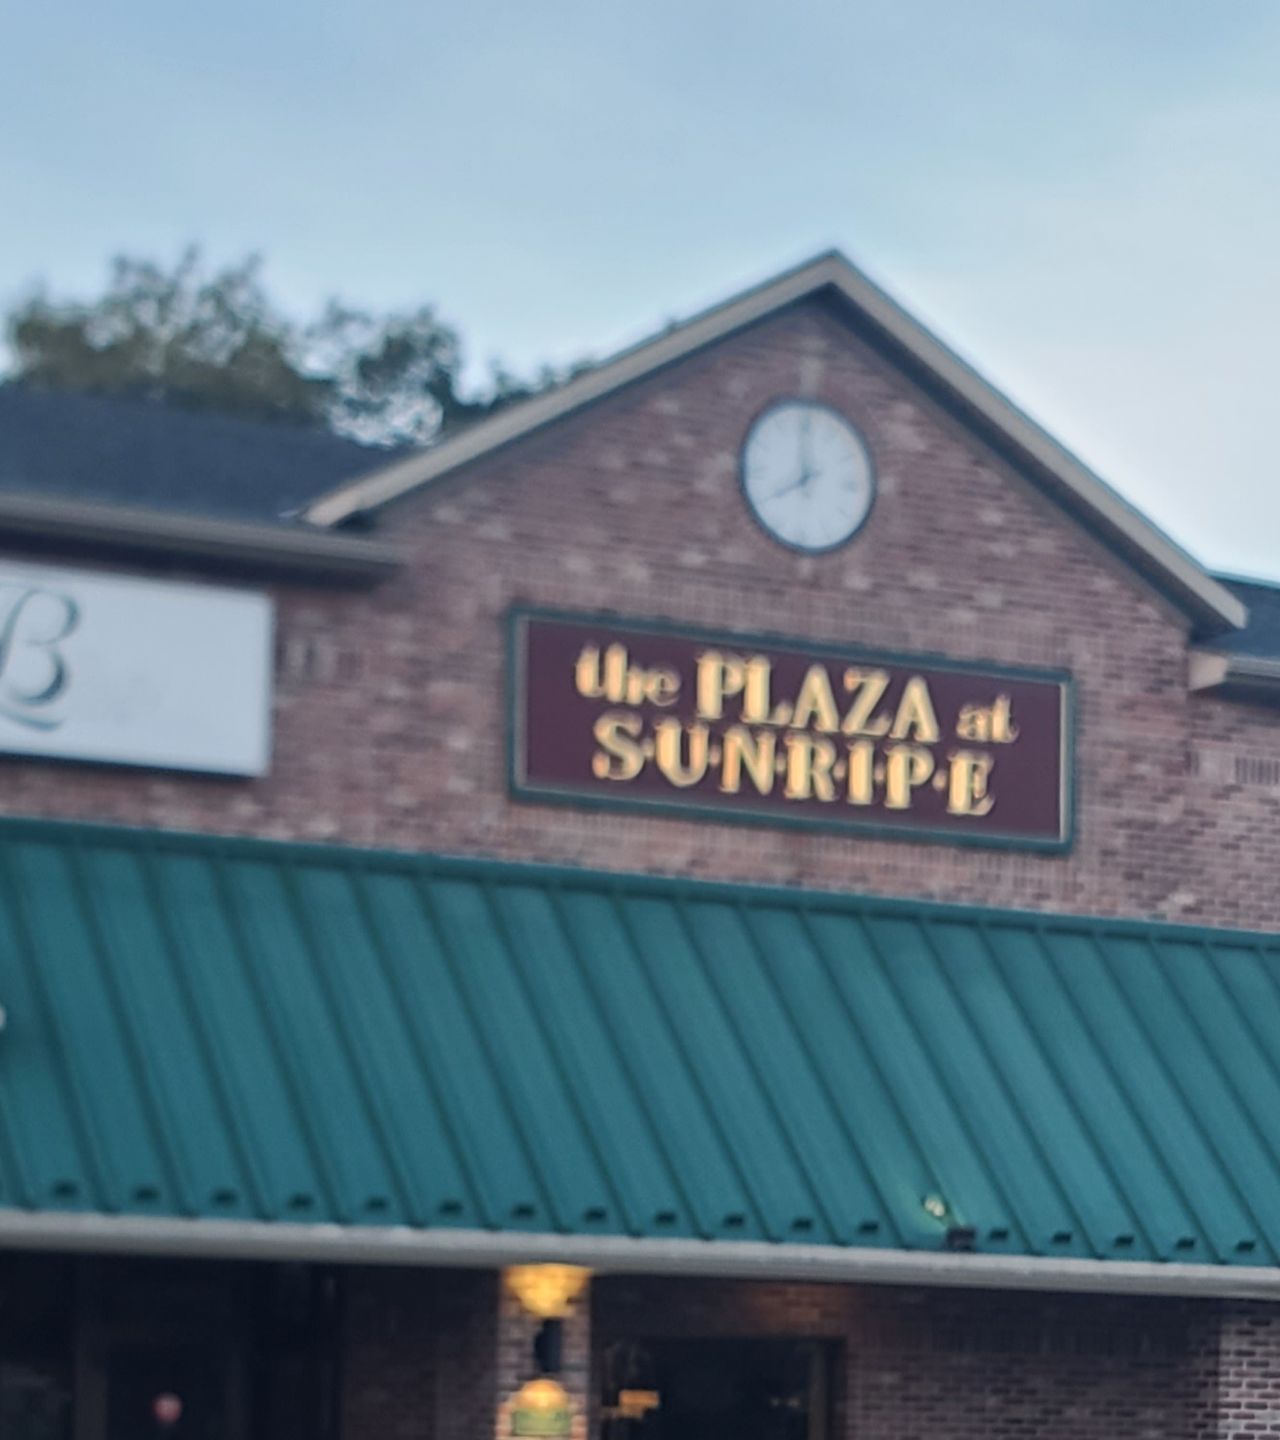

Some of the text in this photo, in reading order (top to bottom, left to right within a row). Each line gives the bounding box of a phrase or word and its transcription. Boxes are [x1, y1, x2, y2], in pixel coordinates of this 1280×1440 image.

[575, 642, 1018, 744] the PLAZA at
